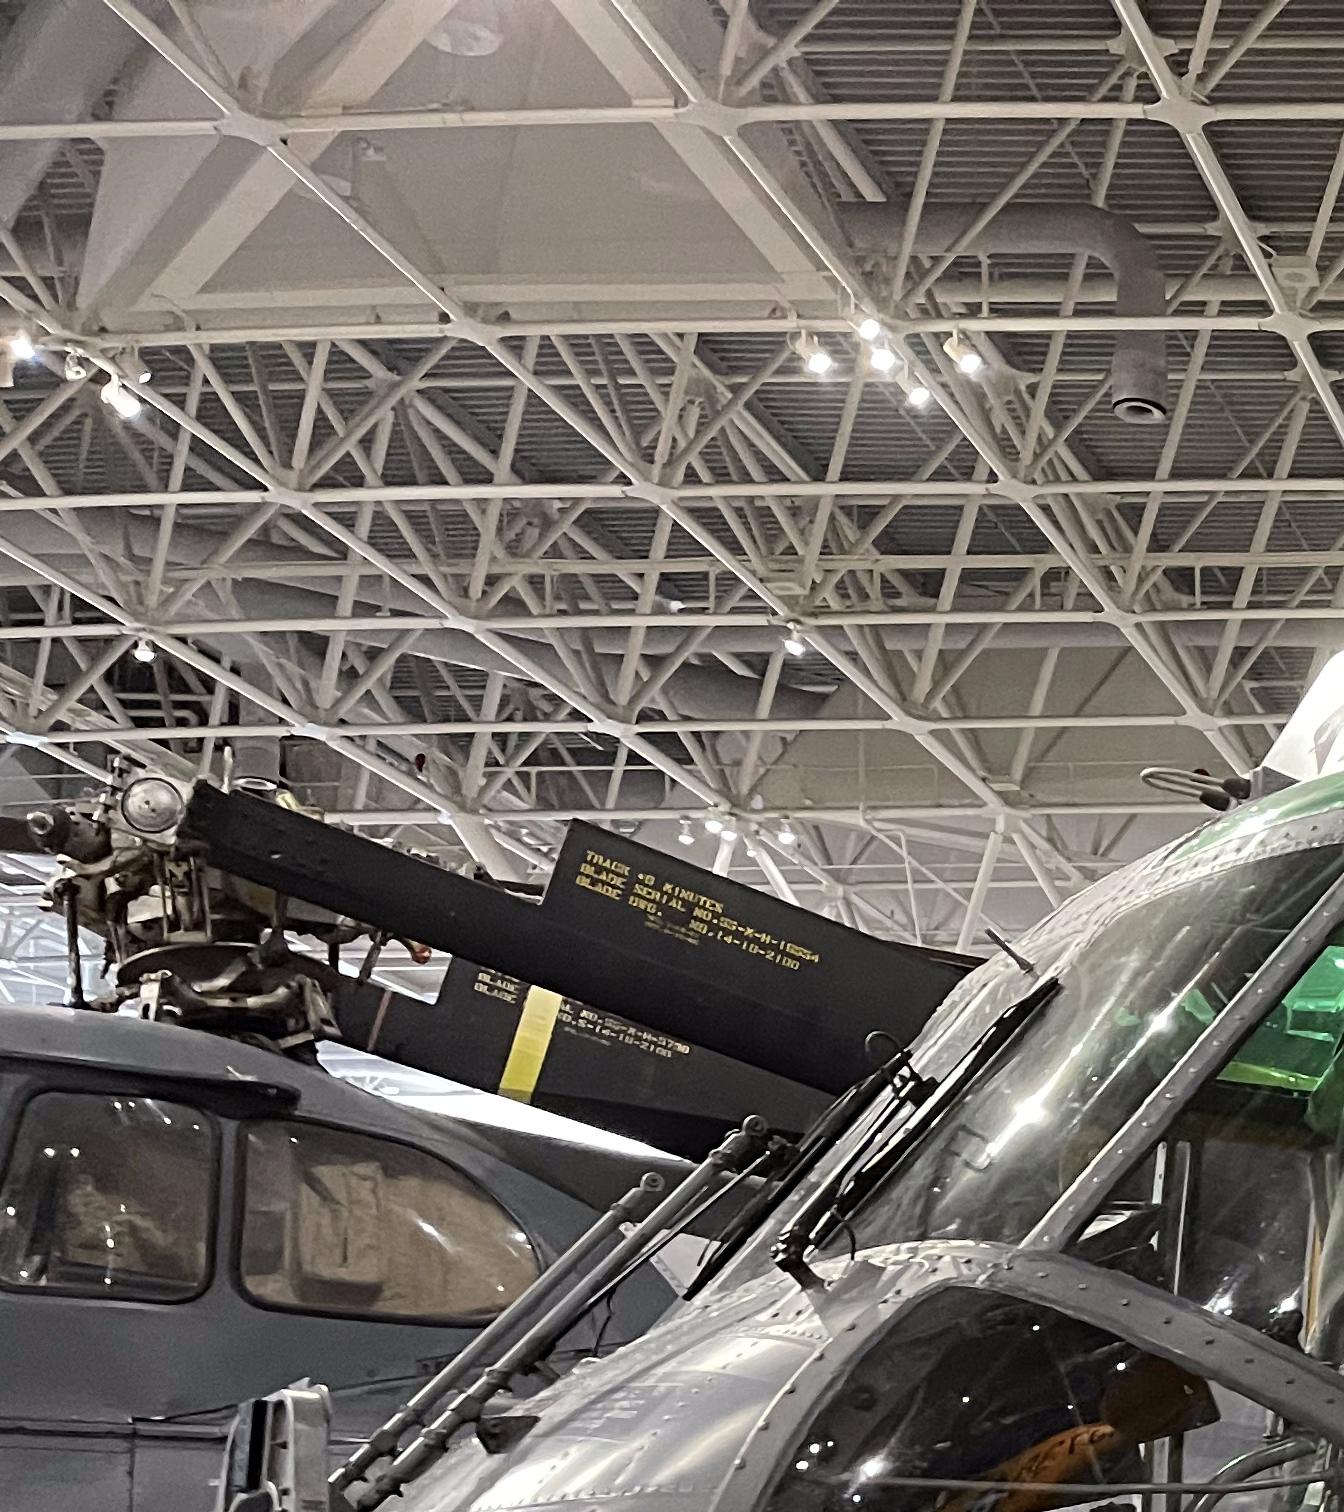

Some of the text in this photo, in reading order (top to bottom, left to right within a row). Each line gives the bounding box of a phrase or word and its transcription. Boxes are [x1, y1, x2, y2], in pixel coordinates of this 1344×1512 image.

[586, 850, 631, 876] TRACK
[575, 875, 623, 900] BLADE
[579, 863, 628, 889] BLADE
[632, 883, 687, 913] SERIAL
